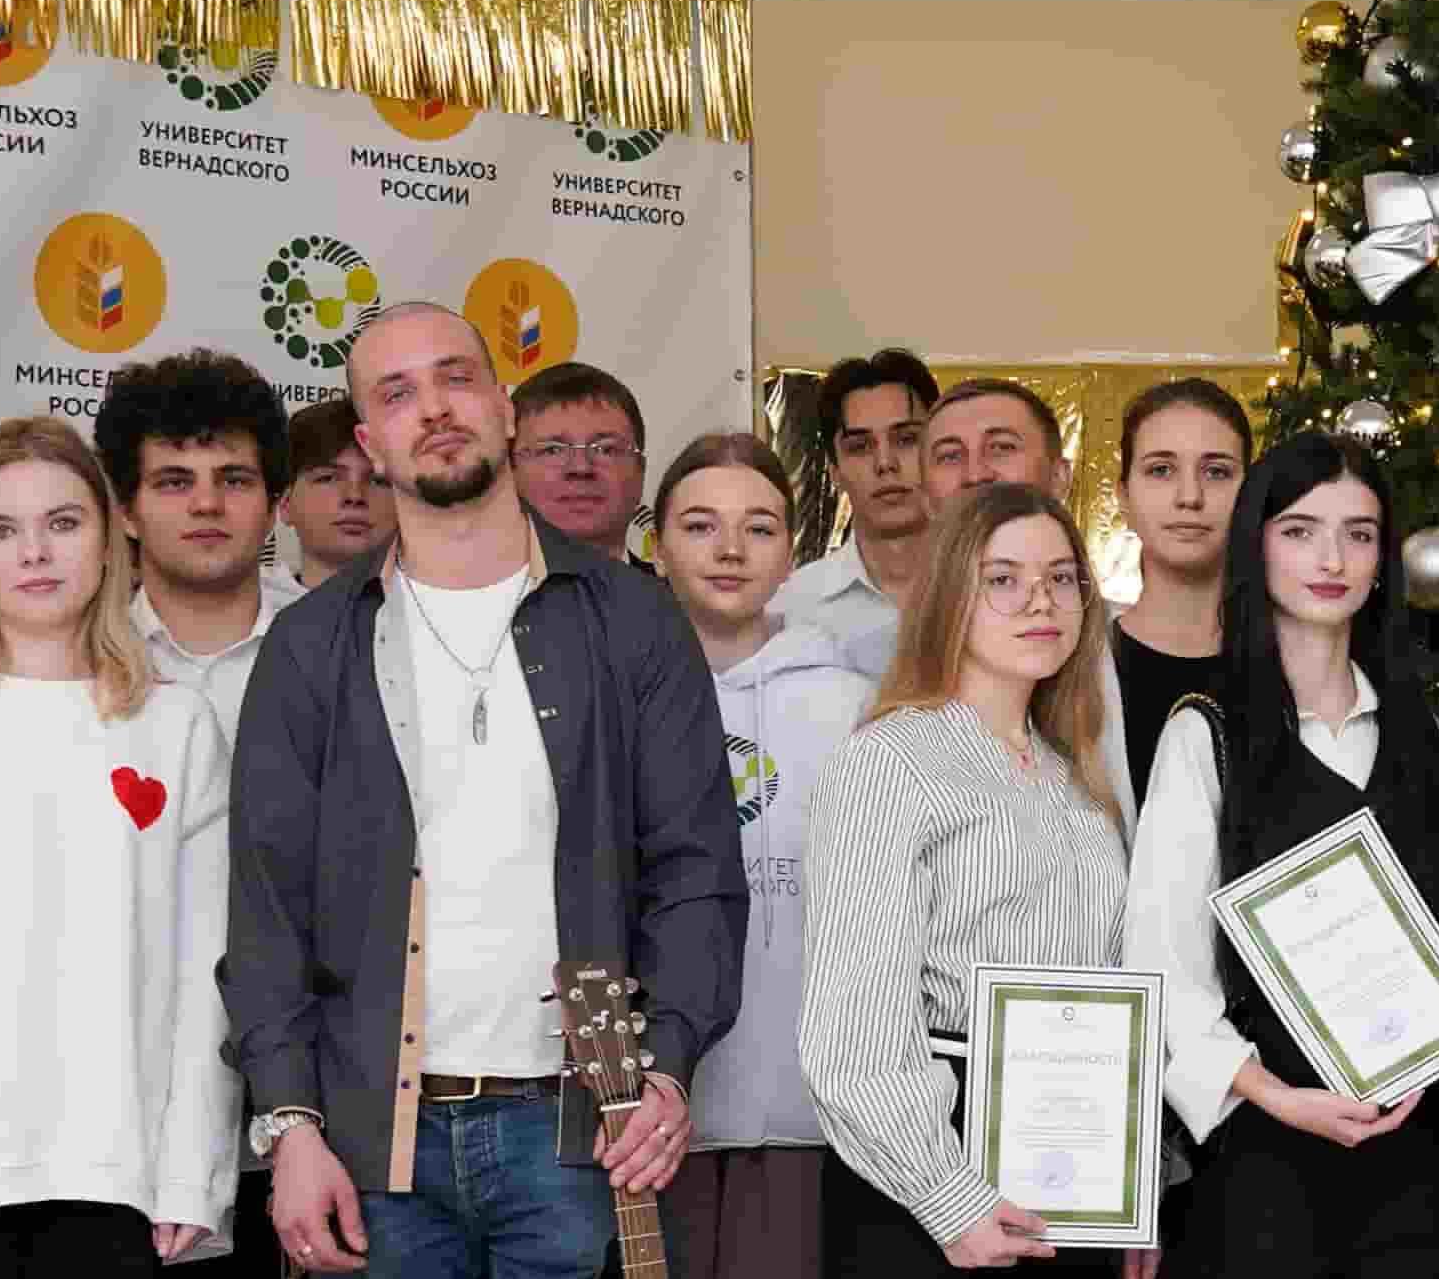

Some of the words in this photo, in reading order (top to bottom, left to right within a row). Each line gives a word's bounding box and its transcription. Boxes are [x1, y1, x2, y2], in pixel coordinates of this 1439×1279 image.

[140, 122, 289, 156] УНИВЕРСИТЕТ
[139, 147, 289, 182] ВЕРНАДСКОГО
[351, 147, 497, 181] МИНСЕЛЬХОЗ
[380, 182, 469, 206] РОССИИ
[552, 172, 682, 202] УНИВЕРСИТЕТ
[551, 197, 686, 226] ВЕРНАДСКОГО
